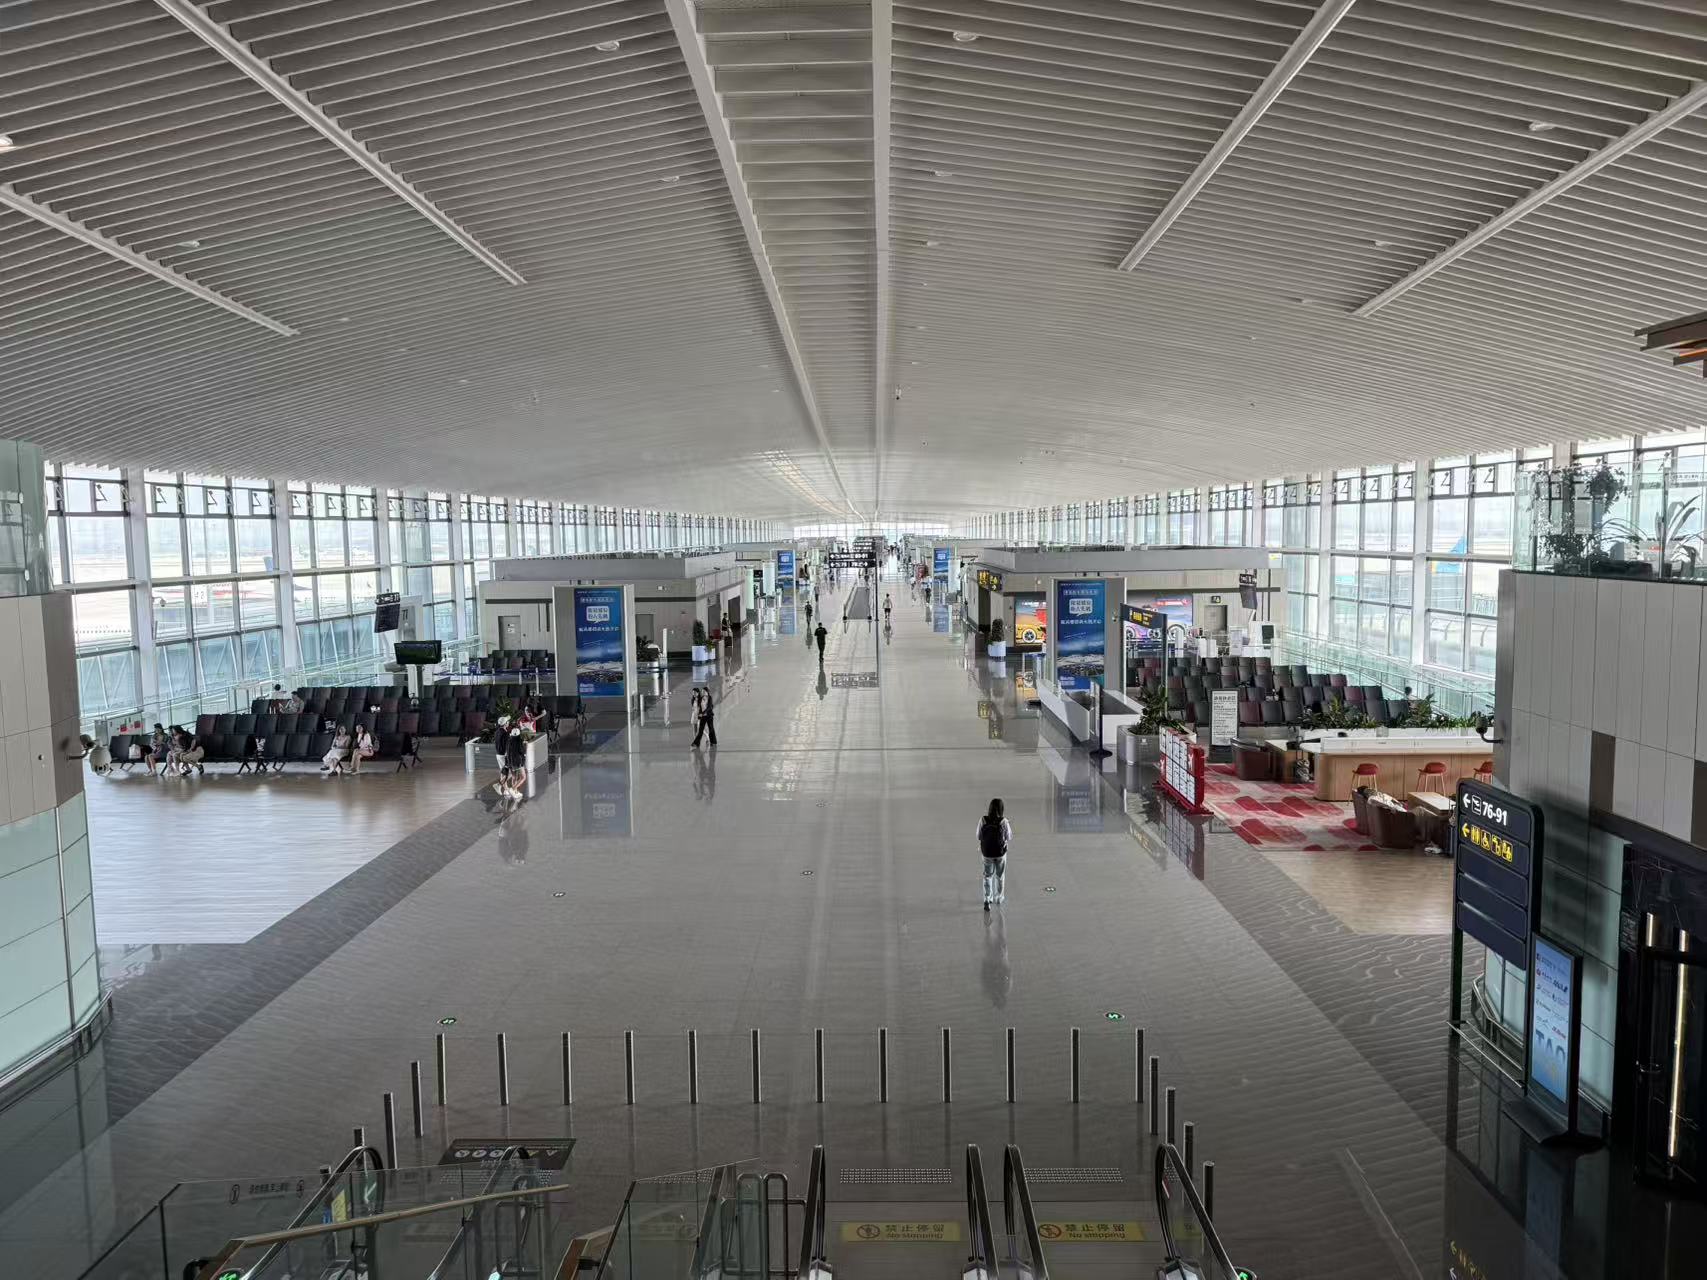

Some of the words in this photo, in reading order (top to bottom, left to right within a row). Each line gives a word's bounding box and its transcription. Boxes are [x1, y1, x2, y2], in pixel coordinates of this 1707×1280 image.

[1482, 801, 1508, 826] 76-91
[885, 1223, 945, 1232] 禁止停留
[1065, 1223, 1125, 1232] 禁止停留
[1084, 1232, 1126, 1240] stopping
